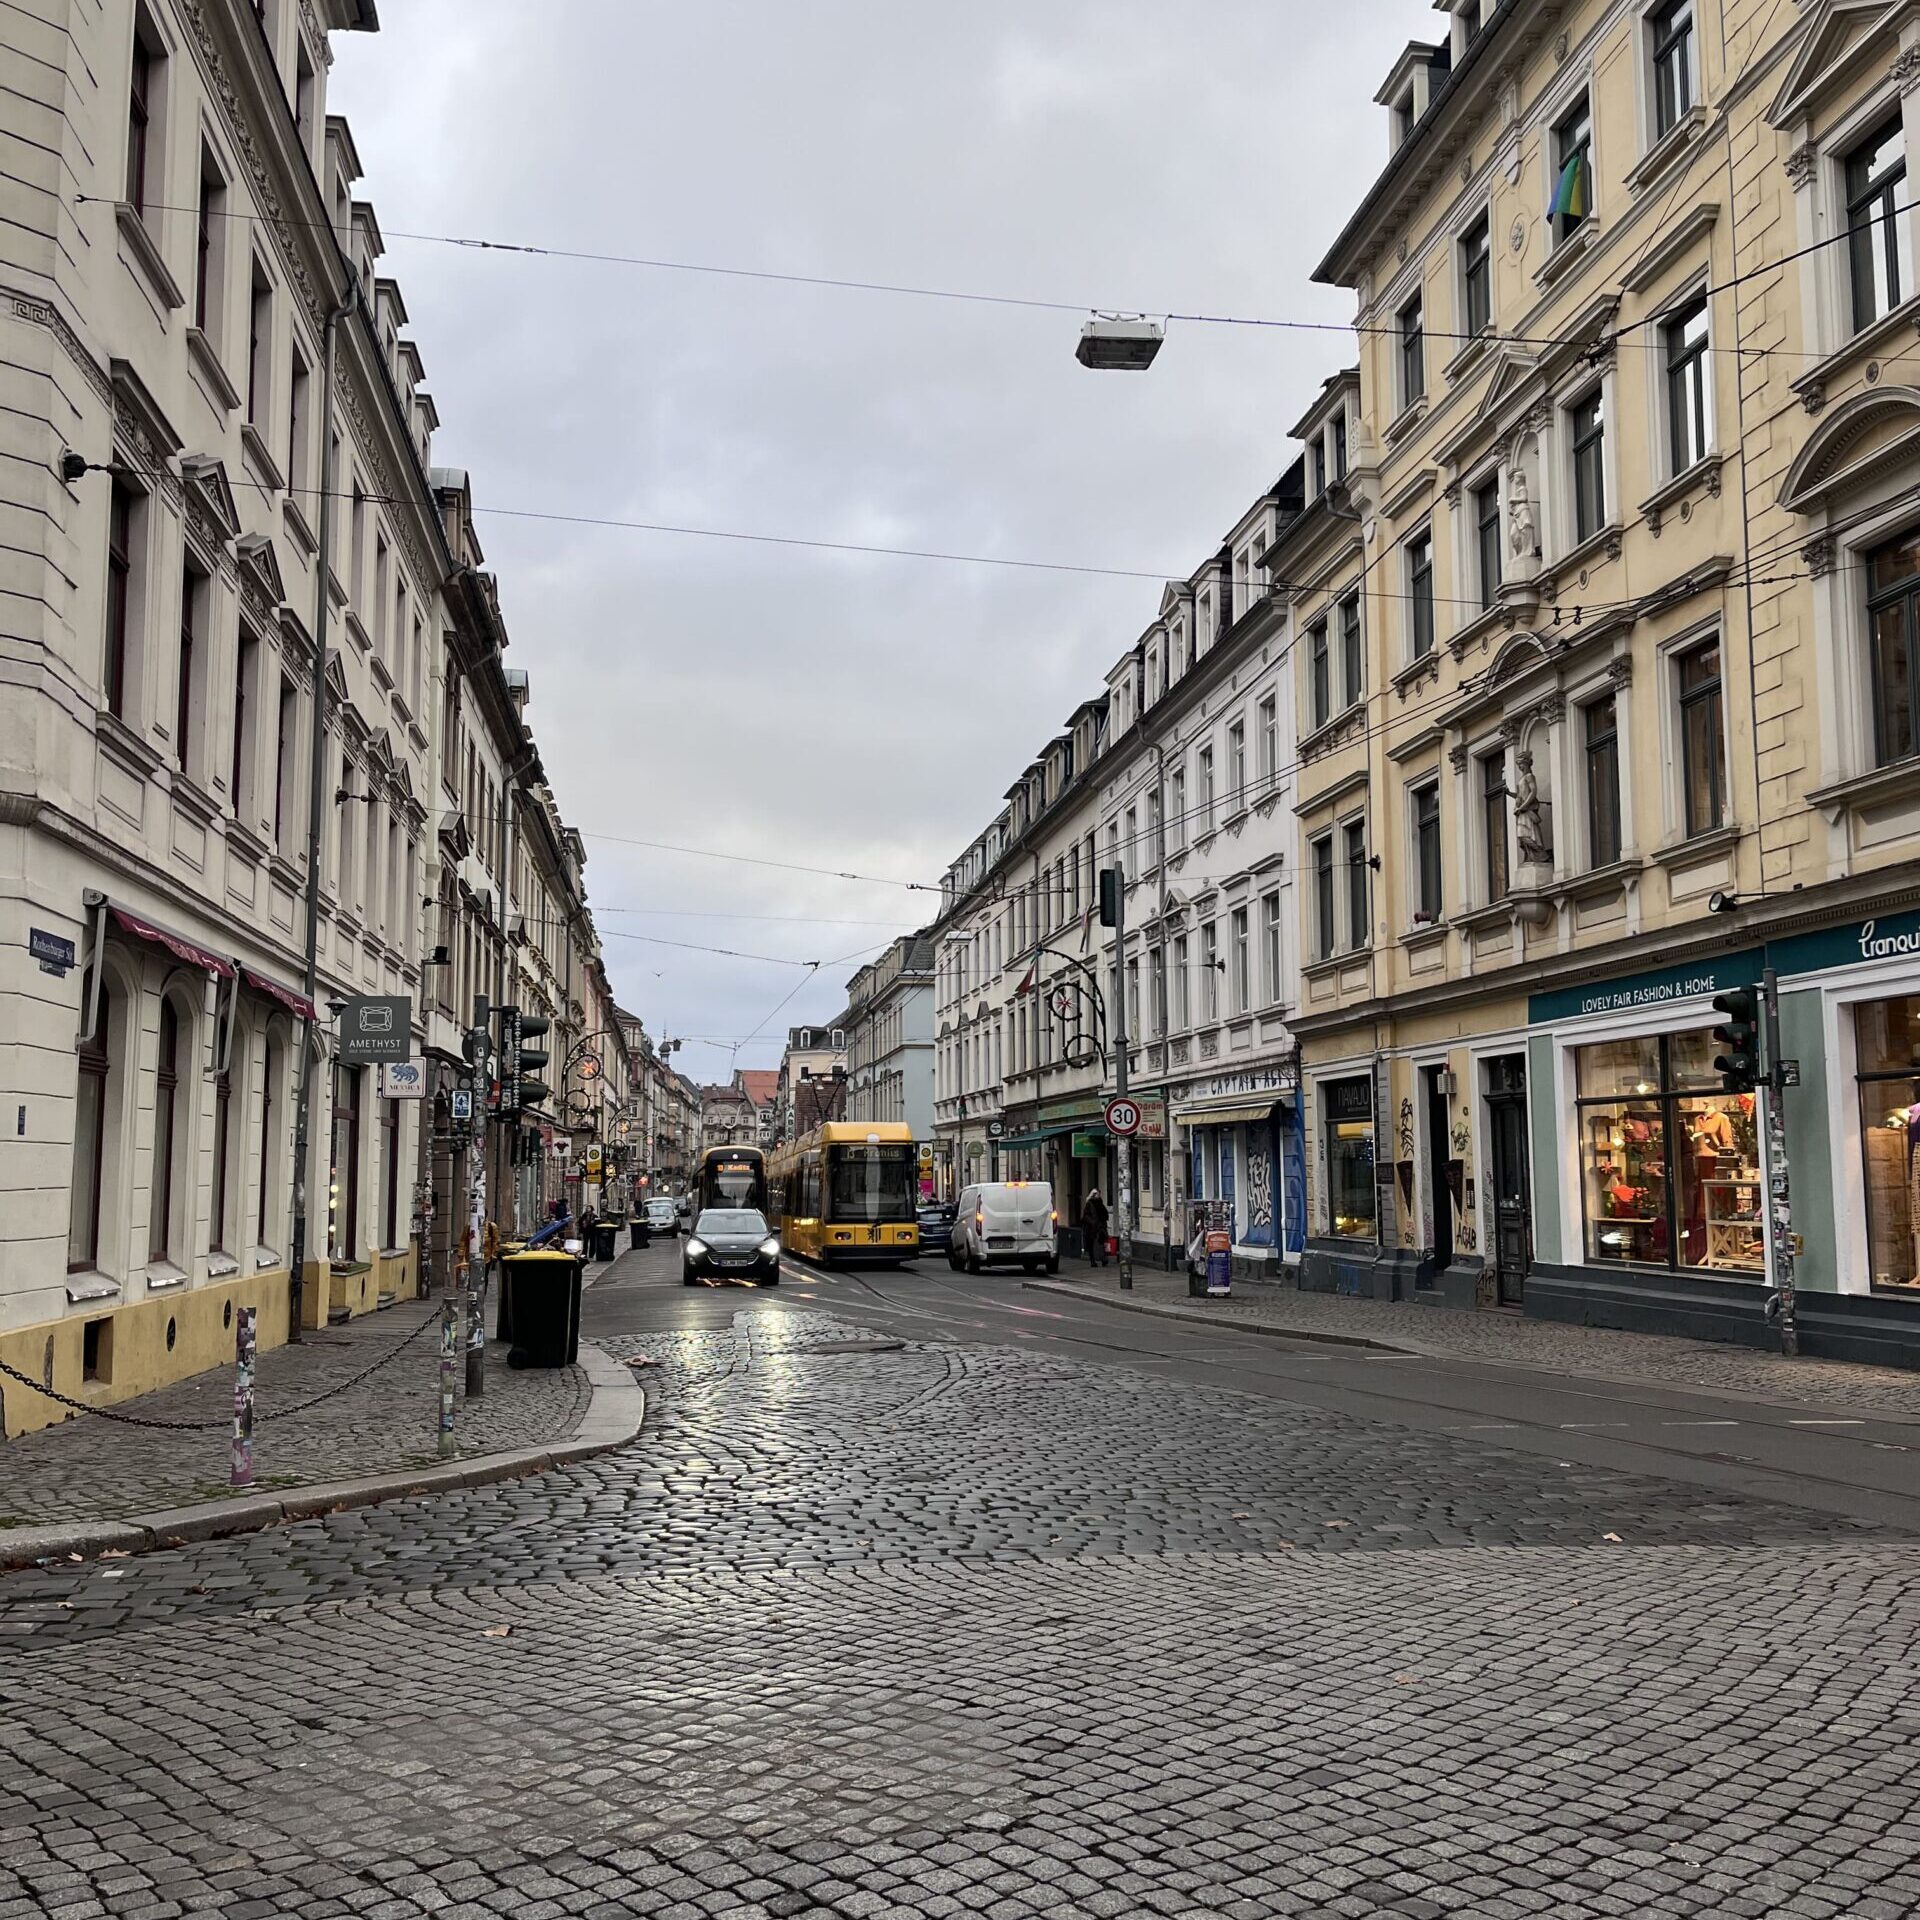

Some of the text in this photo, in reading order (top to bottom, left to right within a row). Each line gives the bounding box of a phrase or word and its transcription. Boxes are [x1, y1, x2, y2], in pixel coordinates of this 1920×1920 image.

[1858, 920, 1920, 957] tranqu
[1582, 976, 1715, 1013] LOVELY FAIR FASHION & HOME
[349, 1040, 401, 1048] AMETHYST
[1113, 1109, 1134, 1124] 30
[1456, 1221, 1477, 1250] ACAB
